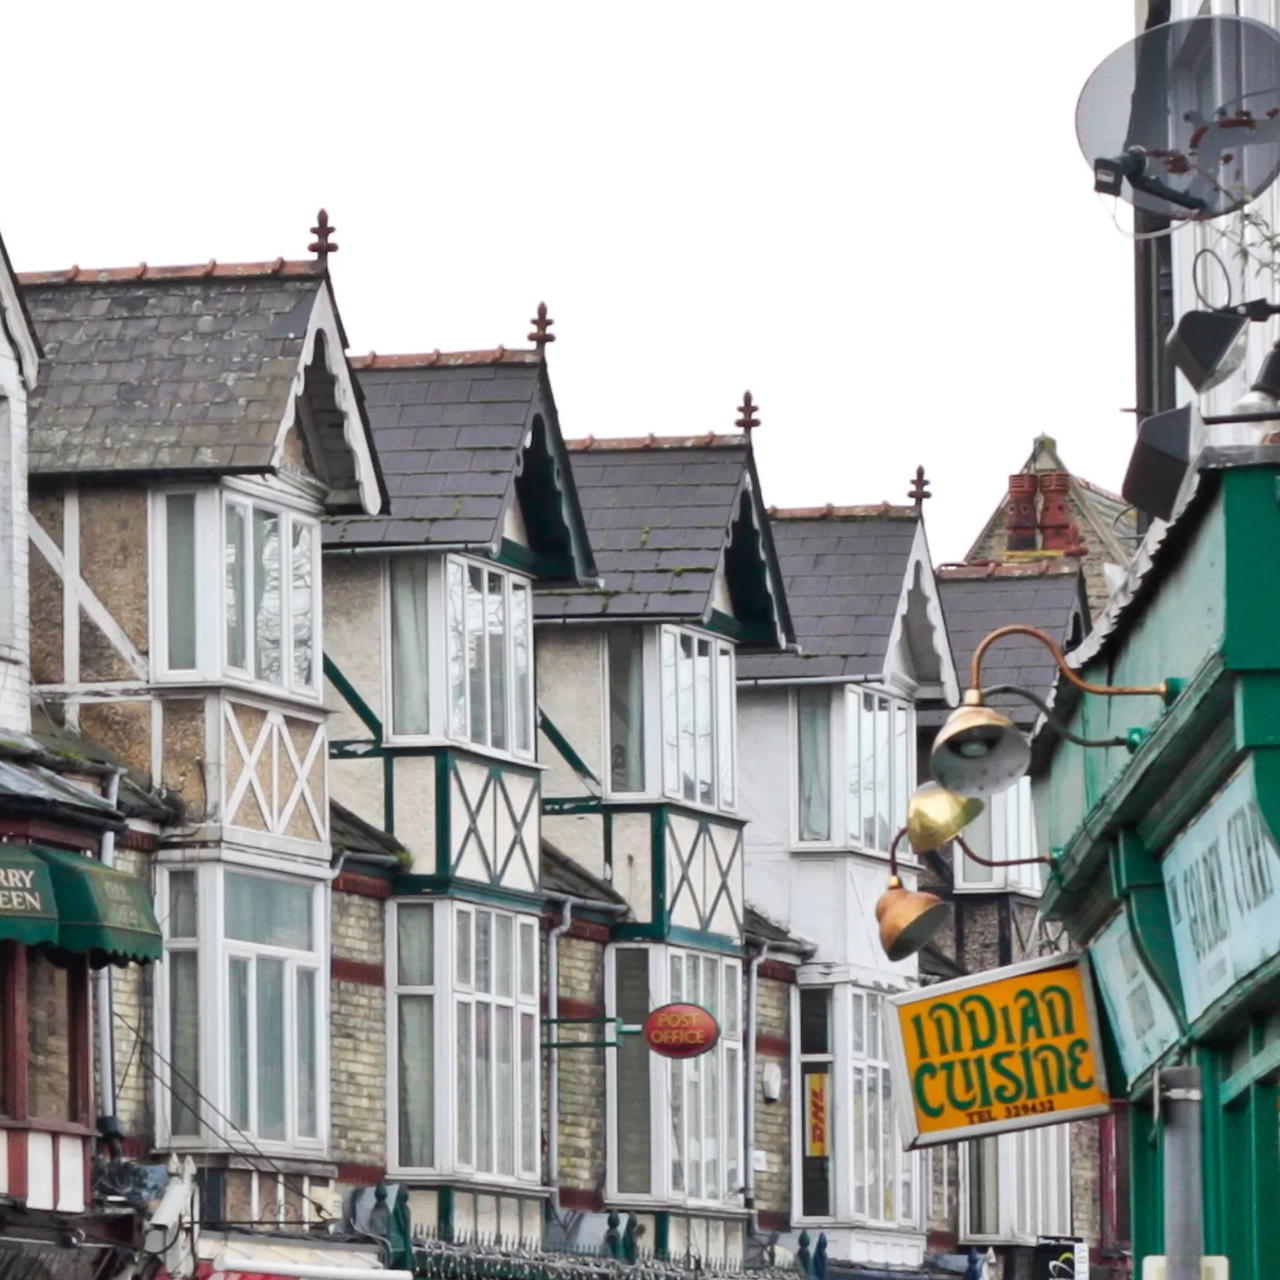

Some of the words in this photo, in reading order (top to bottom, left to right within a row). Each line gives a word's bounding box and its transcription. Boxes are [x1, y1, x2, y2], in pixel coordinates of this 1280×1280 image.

[658, 1012, 701, 1028] POST
[911, 985, 1075, 1059] INDIAN
[650, 1029, 706, 1045] OFFICE
[914, 1038, 1095, 1117] CUISINE
[966, 1109, 998, 1125] TEL
[1005, 1099, 1056, 1119] 329432
